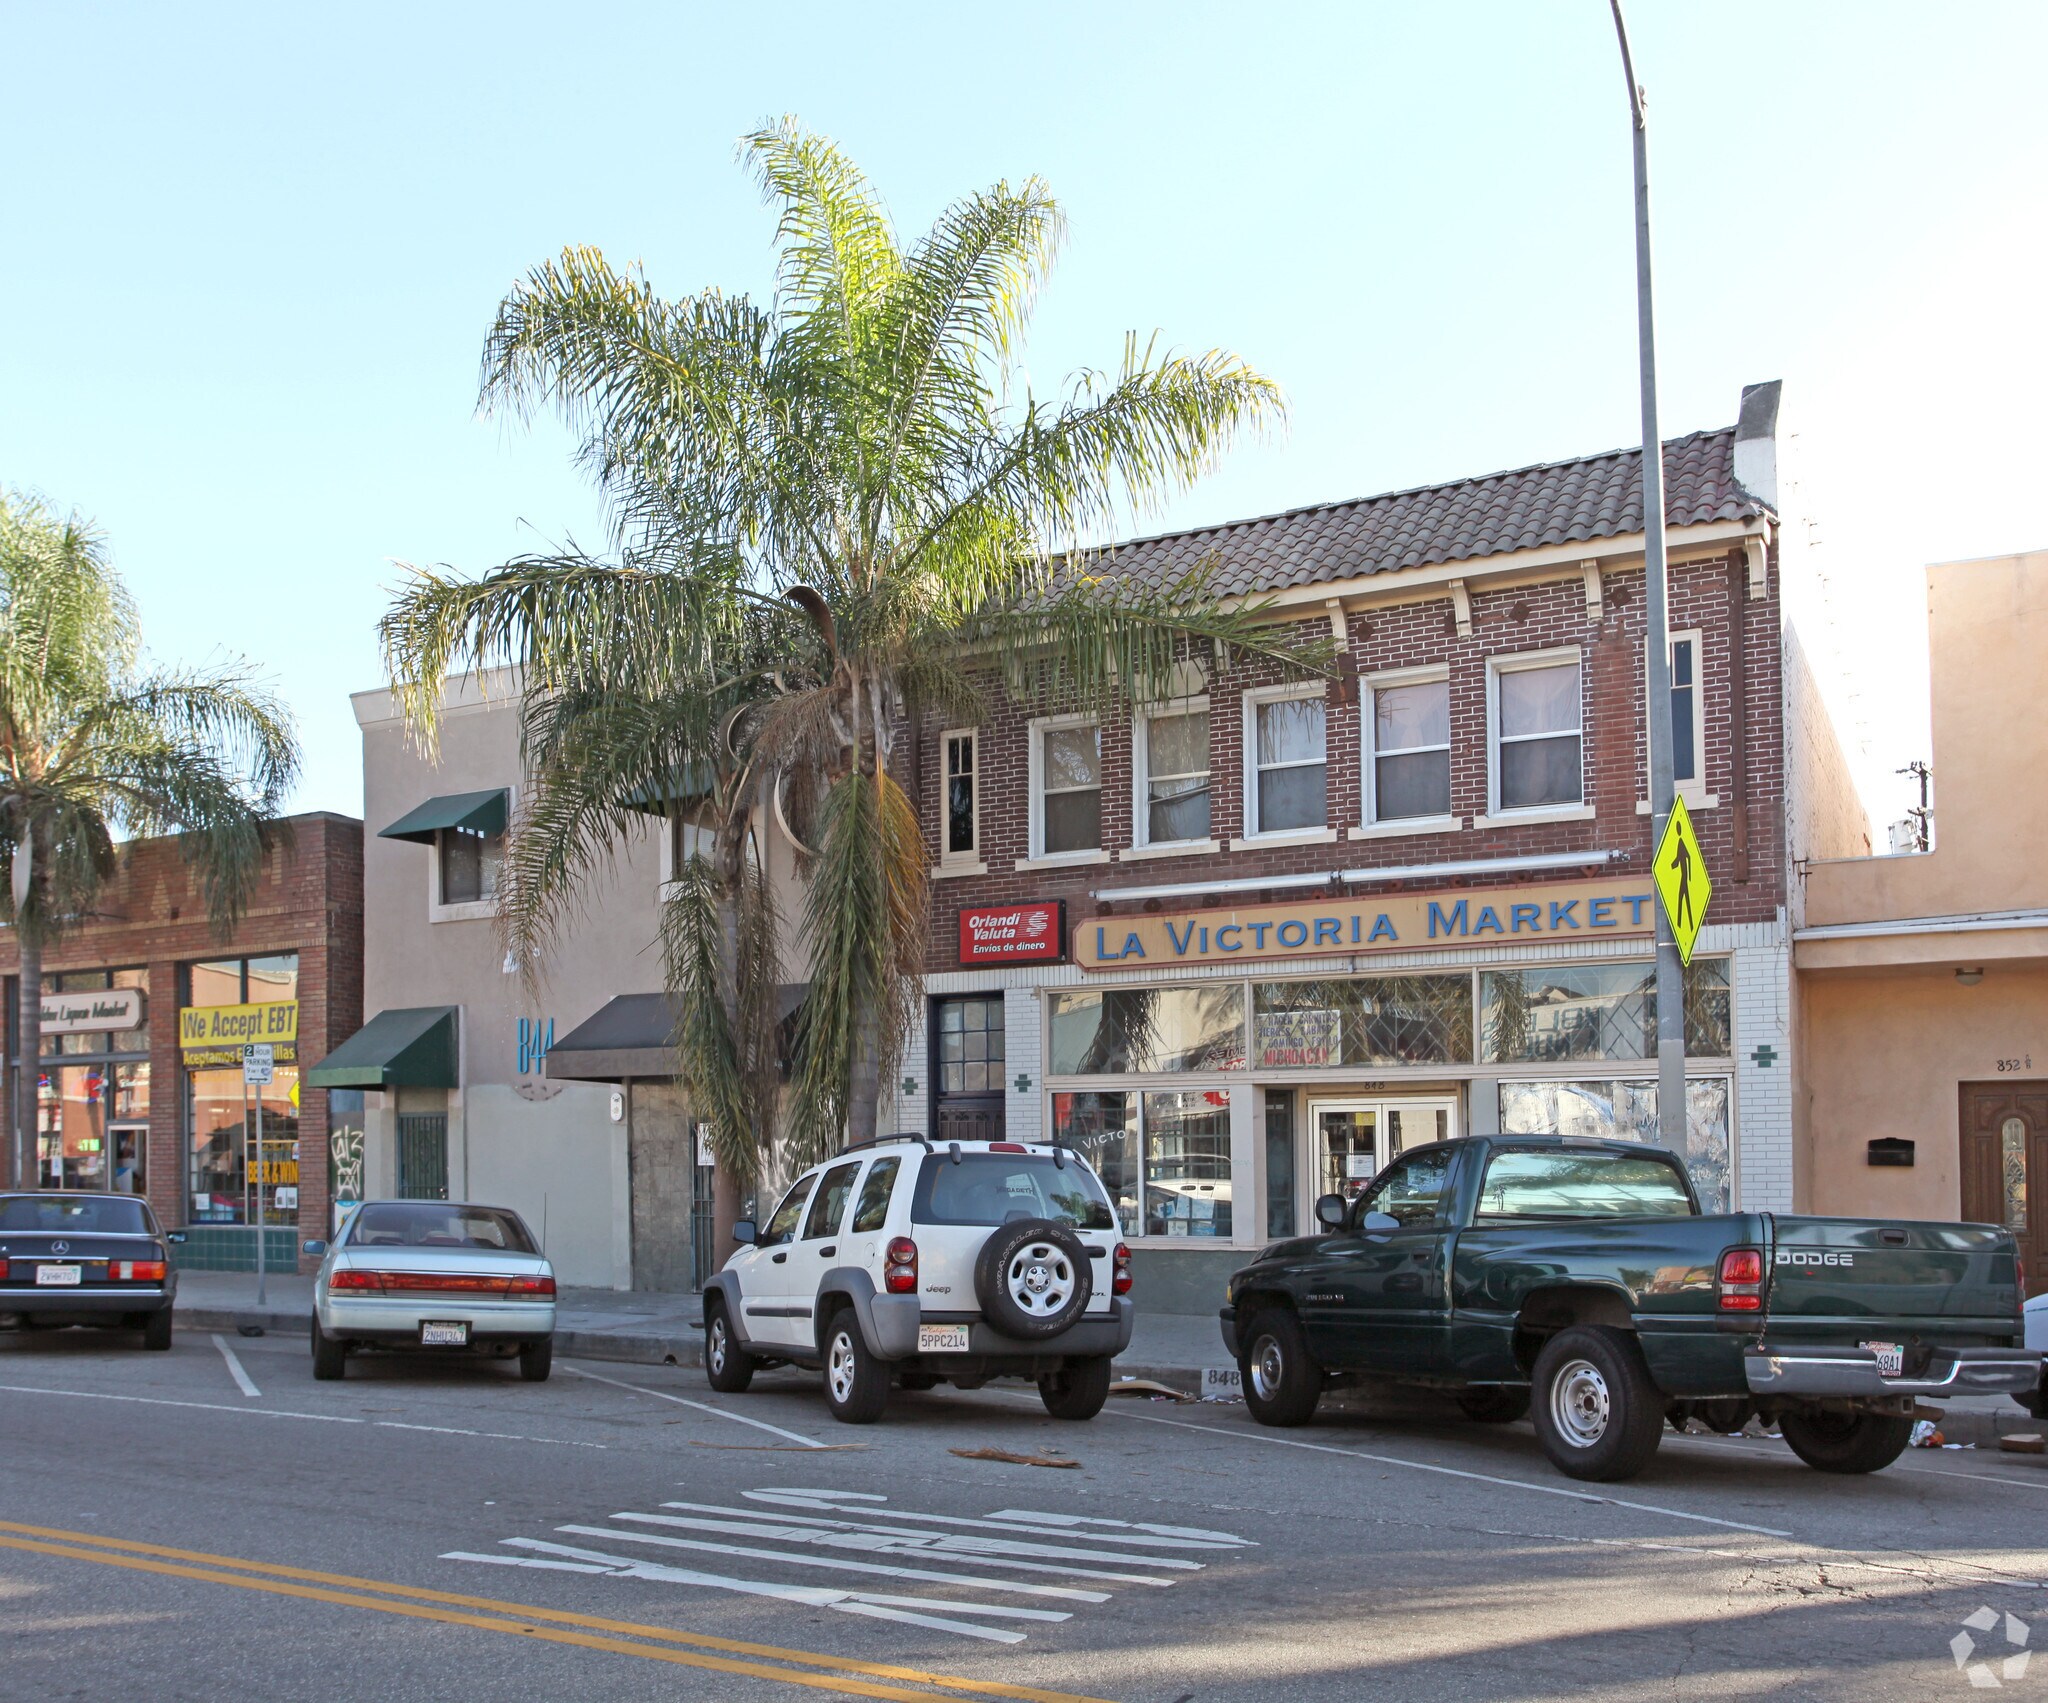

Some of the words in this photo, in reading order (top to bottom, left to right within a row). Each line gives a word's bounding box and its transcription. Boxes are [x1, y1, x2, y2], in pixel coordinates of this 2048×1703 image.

[969, 913, 1021, 929] Orlandi
[1097, 927, 1146, 960] LA
[1165, 914, 1399, 955] VICTORIA
[1427, 894, 1652, 938] MARKET
[974, 927, 1016, 941] Valuta
[1003, 943, 1015, 953] de
[1016, 942, 1046, 951] dinero
[92, 1001, 129, 1018] Market
[183, 1012, 206, 1039] We
[211, 1008, 262, 1042] Accept
[267, 1005, 296, 1034] EBT
[246, 1046, 253, 1056] 2
[517, 1017, 554, 1074] 844
[183, 1051, 235, 1068] Aceptamos
[246, 1058, 271, 1067] PARKING
[1997, 1059, 2021, 1072] 852
[1775, 1252, 1854, 1267] DODGE
[925, 1284, 952, 1294] Jeep
[921, 1334, 966, 1348] 5PPC214
[1877, 1354, 1900, 1371] 68A1
[1208, 1369, 1240, 1386] 848
